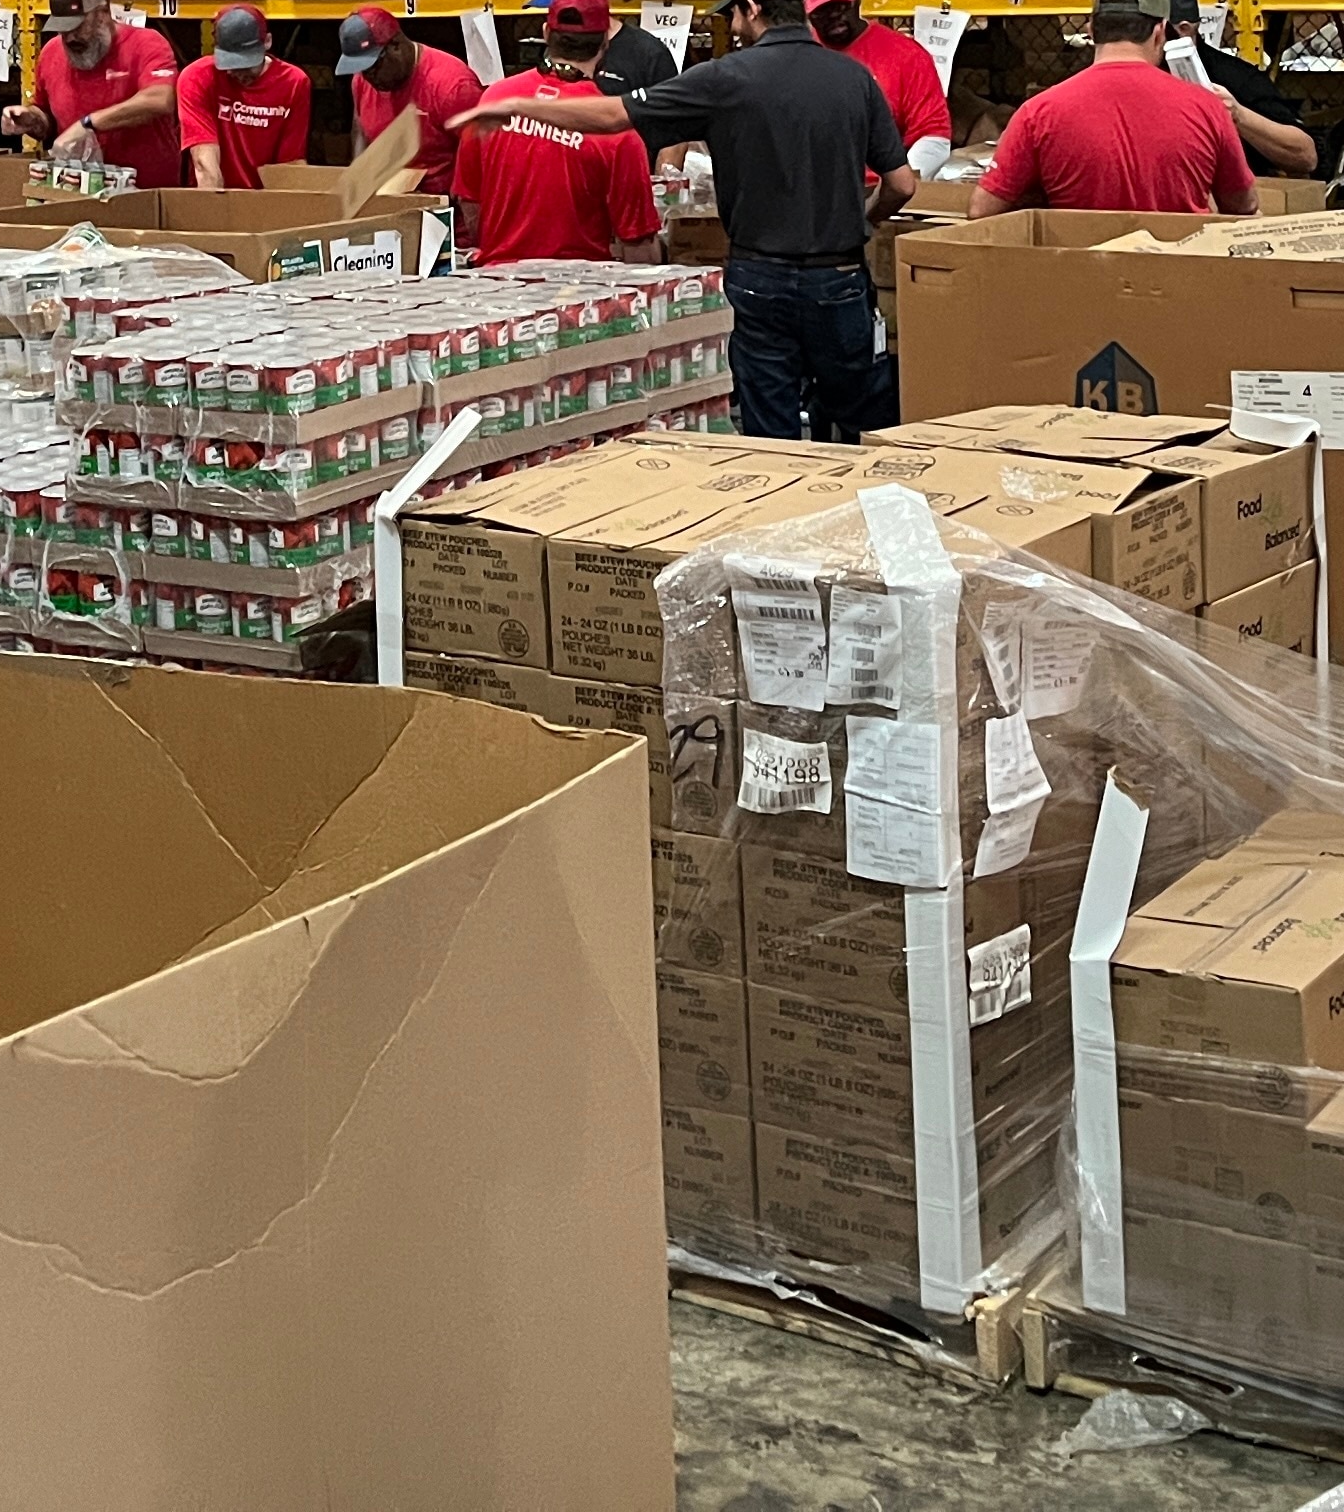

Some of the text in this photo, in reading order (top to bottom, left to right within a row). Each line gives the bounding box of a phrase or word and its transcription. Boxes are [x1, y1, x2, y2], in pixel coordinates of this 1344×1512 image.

[656, 14, 678, 26] VEG
[233, 101, 290, 119] Community
[502, 115, 583, 150] OLUNTEER
[334, 249, 394, 272] Cleaning
[1238, 494, 1262, 520] Food
[425, 532, 446, 542] STEW
[442, 543, 464, 554] CODE
[438, 552, 459, 563] DATE
[575, 553, 624, 566] BEEF STEW
[433, 563, 466, 575] PACKED
[492, 559, 508, 569] LOT
[483, 569, 518, 582] NUMBER
[576, 563, 644, 579] PRODUCT CODE
[615, 577, 637, 587] DATE
[419, 593, 431, 604] OZ
[610, 588, 645, 600] PACKED
[410, 617, 445, 631] WEIGHT
[561, 615, 571, 626] 24
[581, 618, 591, 628] 24
[594, 620, 608, 630] OZ
[622, 623, 634, 634] LB
[562, 629, 610, 645] POUCHES
[562, 641, 582, 652] NET
[585, 644, 624, 658] WEIGHT
[429, 663, 453, 673] STEW
[407, 671, 445, 683] PRODUCT
[500, 690, 517, 700] LOT
[575, 687, 626, 701] BEEF STEW
[575, 697, 644, 713] PRODUCT CODE
[615, 711, 638, 722] DATE
